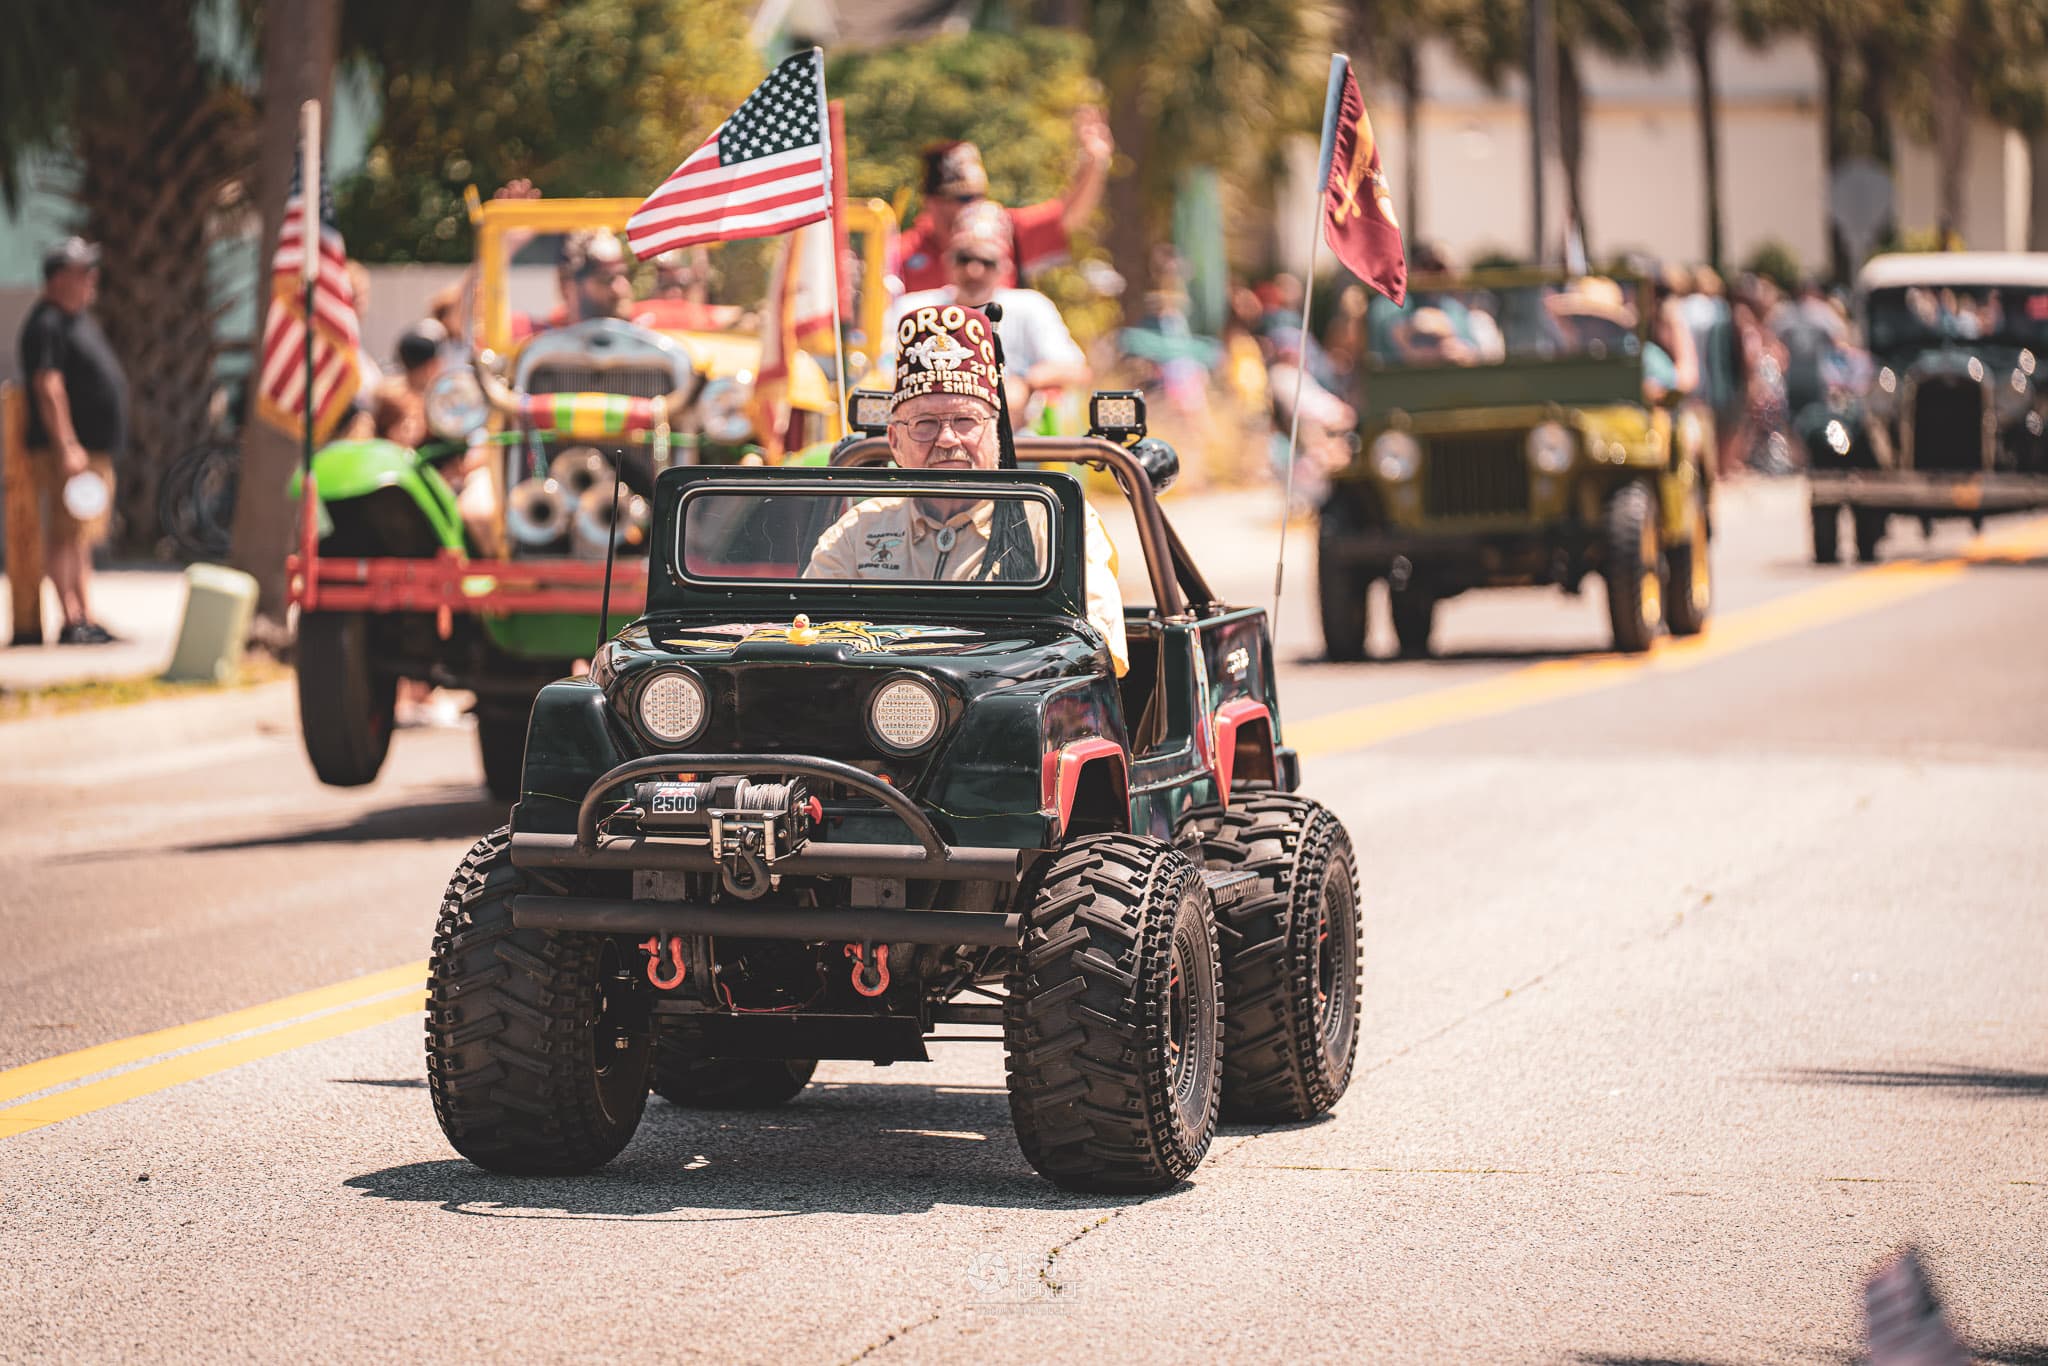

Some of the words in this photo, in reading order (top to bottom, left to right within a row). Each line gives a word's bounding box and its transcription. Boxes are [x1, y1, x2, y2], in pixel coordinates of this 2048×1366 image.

[970, 360, 986, 376] 23
[902, 370, 980, 389] PRESIDENT
[653, 796, 696, 812] 2500
